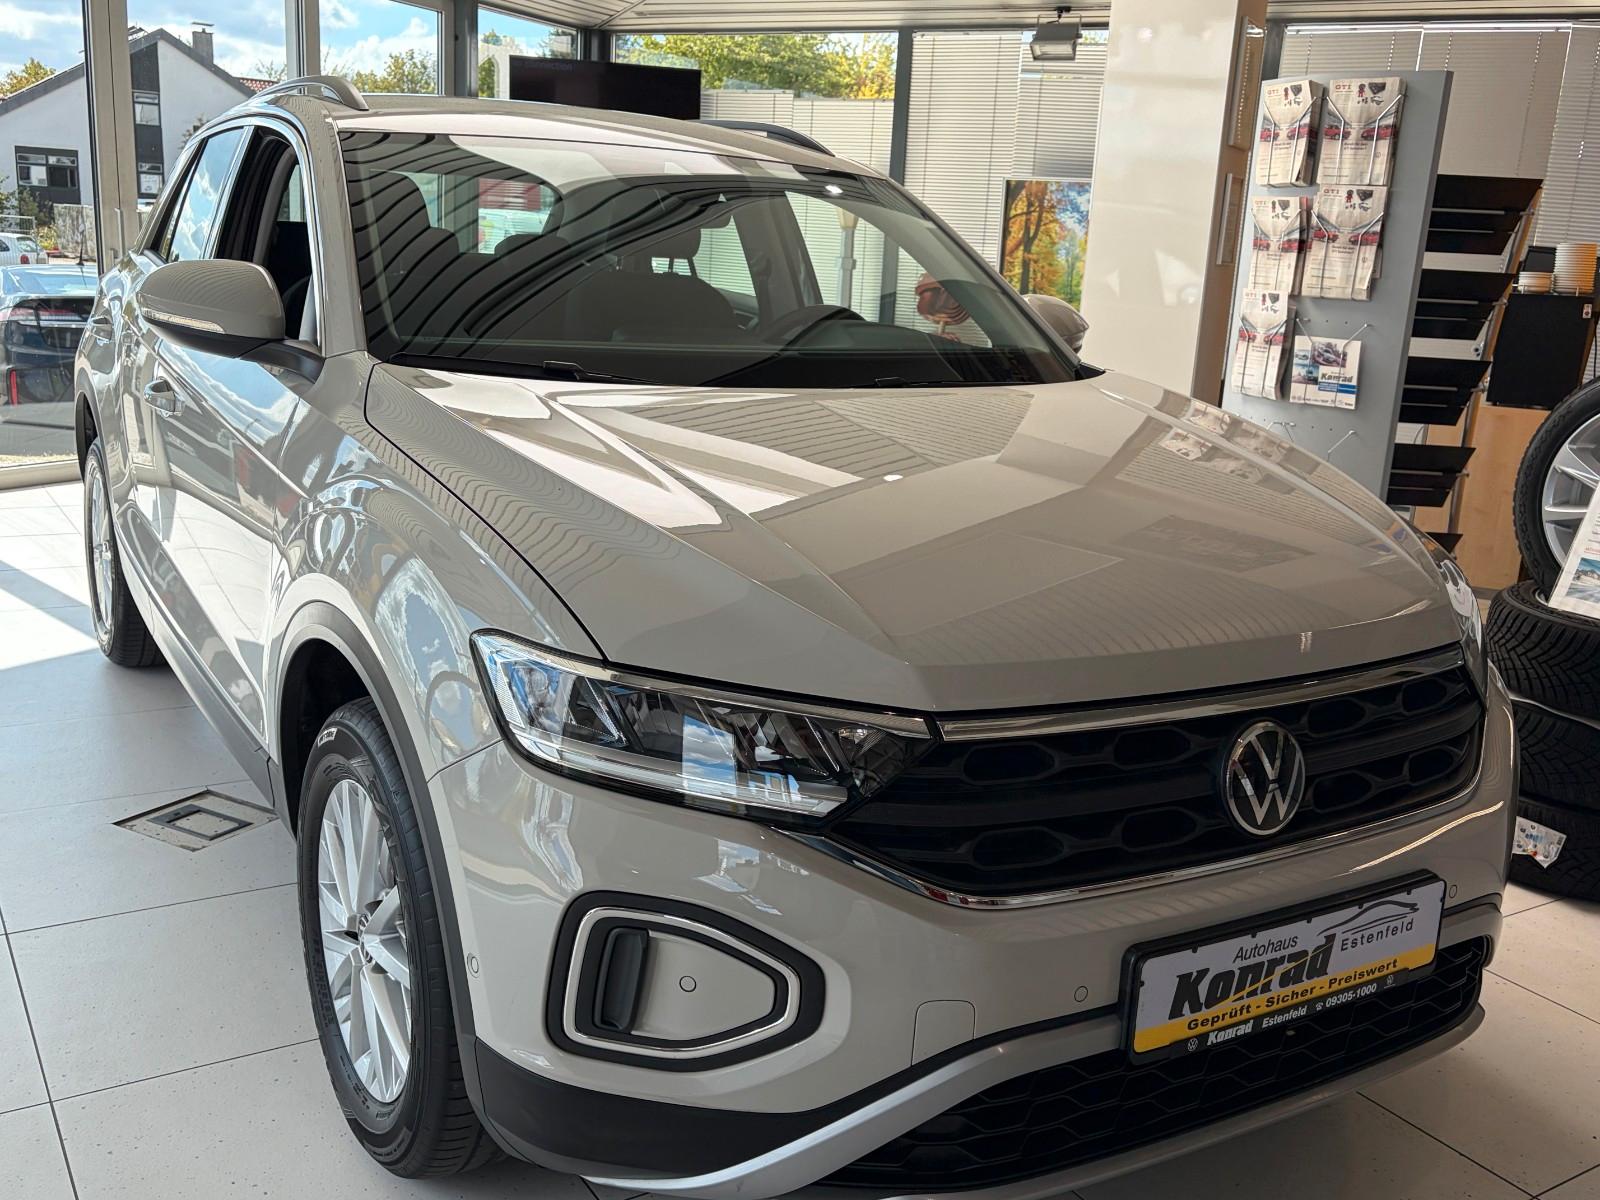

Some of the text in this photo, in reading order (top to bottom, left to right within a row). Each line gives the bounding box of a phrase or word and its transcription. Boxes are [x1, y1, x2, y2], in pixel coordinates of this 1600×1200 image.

[1232, 935, 1299, 964] Autohaus
[1340, 918, 1414, 952] Estenfeld
[1168, 932, 1337, 1020] Konrad
[1187, 1002, 1252, 1031] Geprüft
[1265, 984, 1317, 1009] Sicher
[1328, 958, 1398, 990] Preiswert
[1206, 982, 1378, 1046] Konrad Estenfeld 09305-1000
